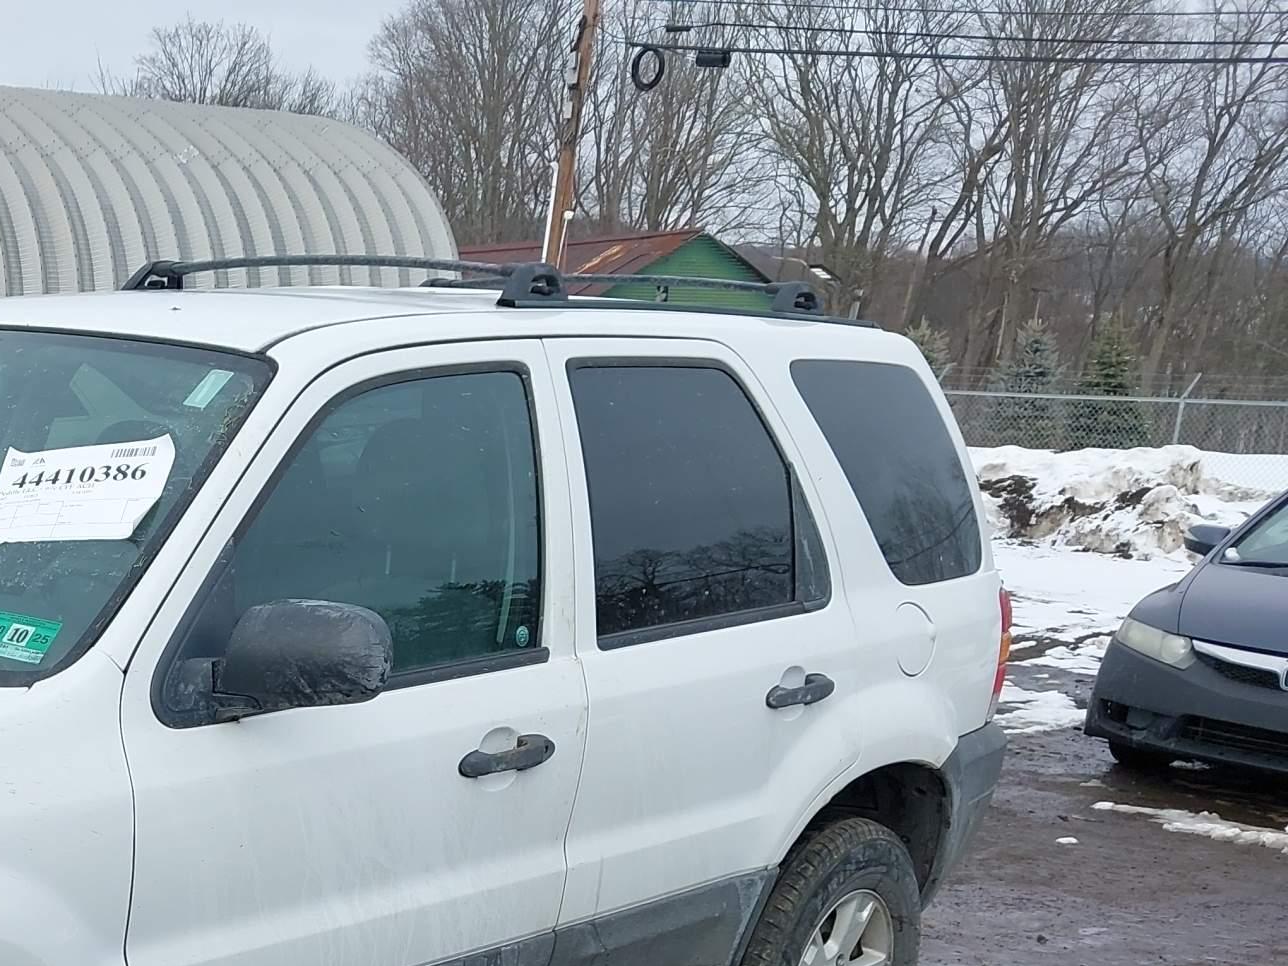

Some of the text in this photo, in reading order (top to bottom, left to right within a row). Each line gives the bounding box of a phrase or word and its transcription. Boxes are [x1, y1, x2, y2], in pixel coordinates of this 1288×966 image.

[12, 462, 150, 489] 44410386
[7, 627, 30, 643] 10
[32, 633, 50, 645] 25
